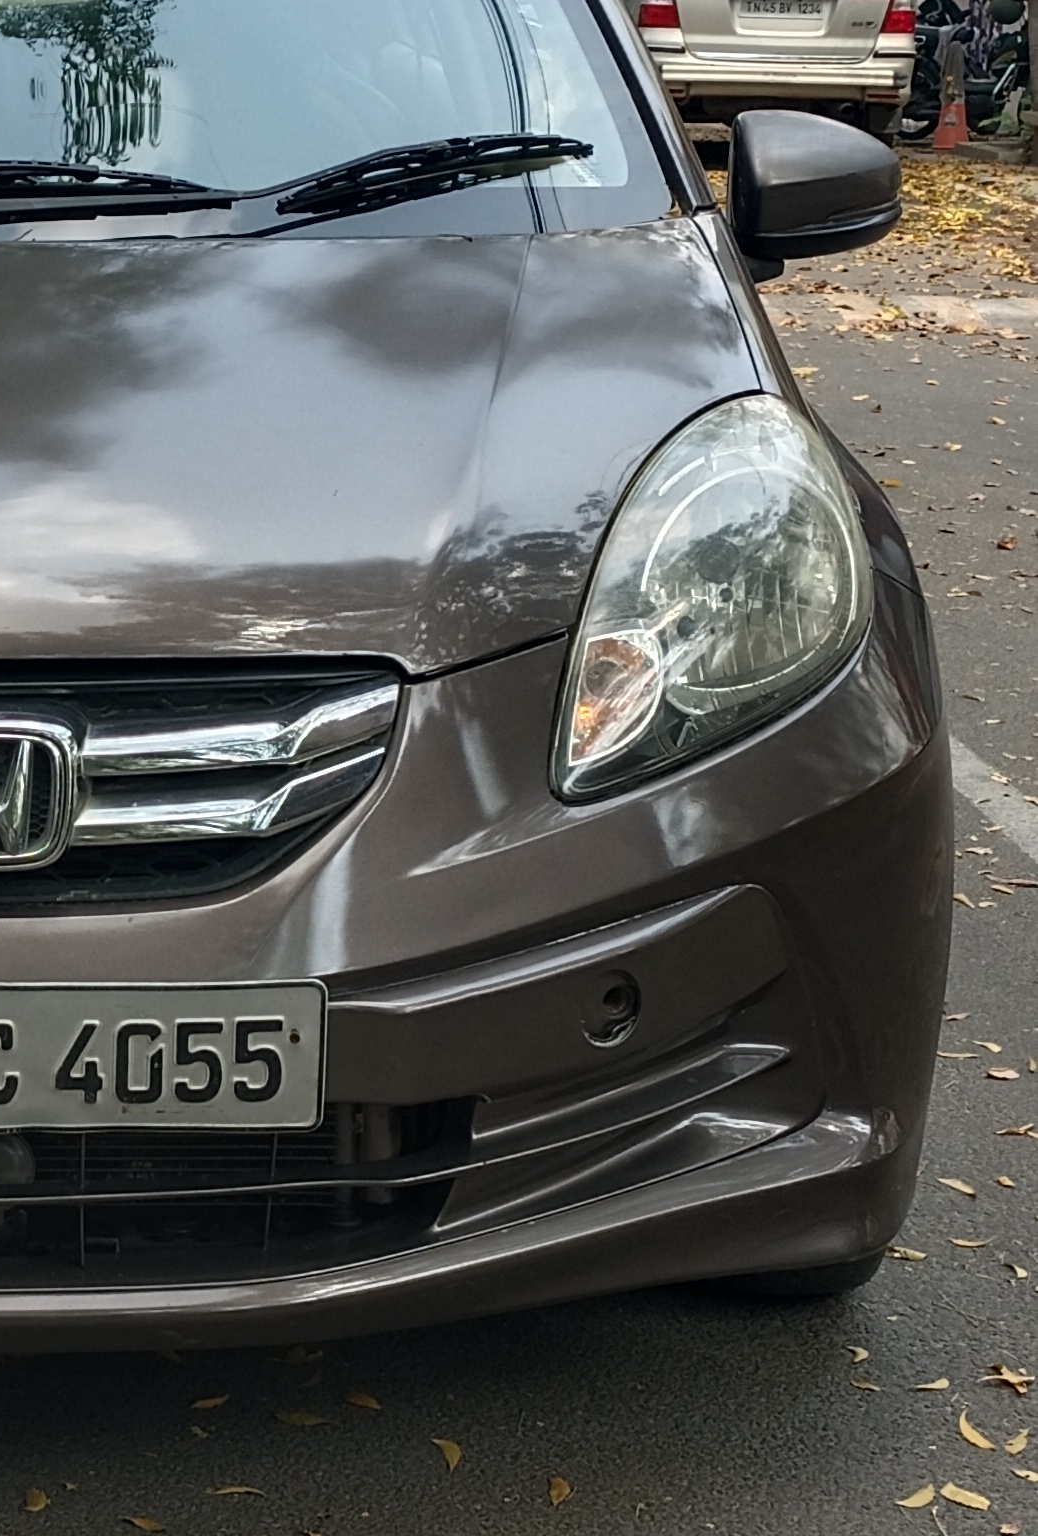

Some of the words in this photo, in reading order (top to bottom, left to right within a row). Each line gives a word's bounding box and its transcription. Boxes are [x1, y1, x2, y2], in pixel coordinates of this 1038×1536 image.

[747, 1, 761, 13] TN
[762, 1, 777, 14] 45
[779, 2, 793, 14] BV
[798, 2, 821, 15] 1234
[54, 1016, 284, 1105] 4055
